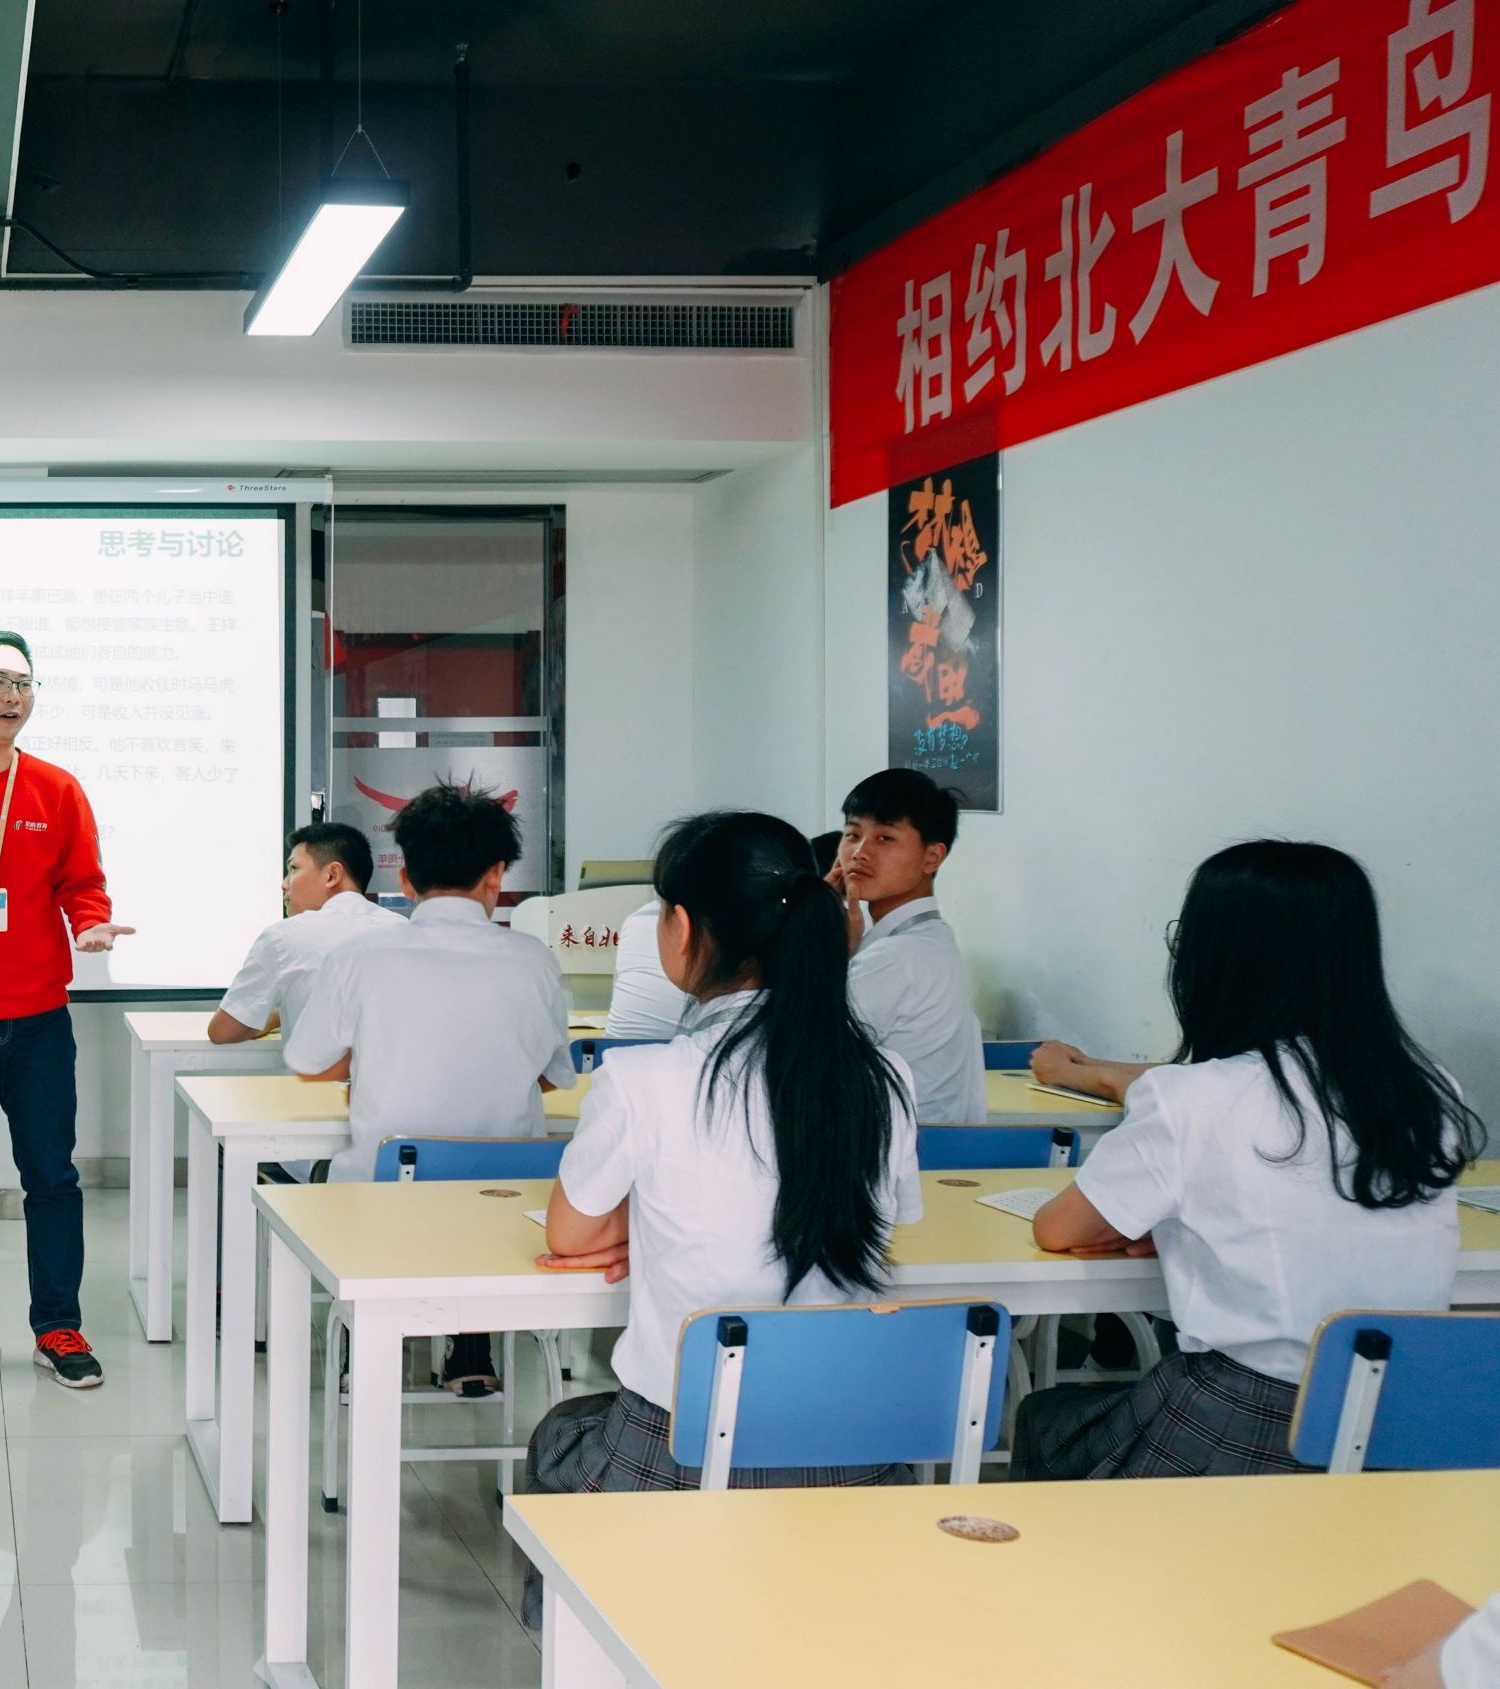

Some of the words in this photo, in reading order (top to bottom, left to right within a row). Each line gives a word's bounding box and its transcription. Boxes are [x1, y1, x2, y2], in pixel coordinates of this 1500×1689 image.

[895, 0, 1492, 435] 相约北大青鸟
[98, 529, 244, 558] 思考与讨论
